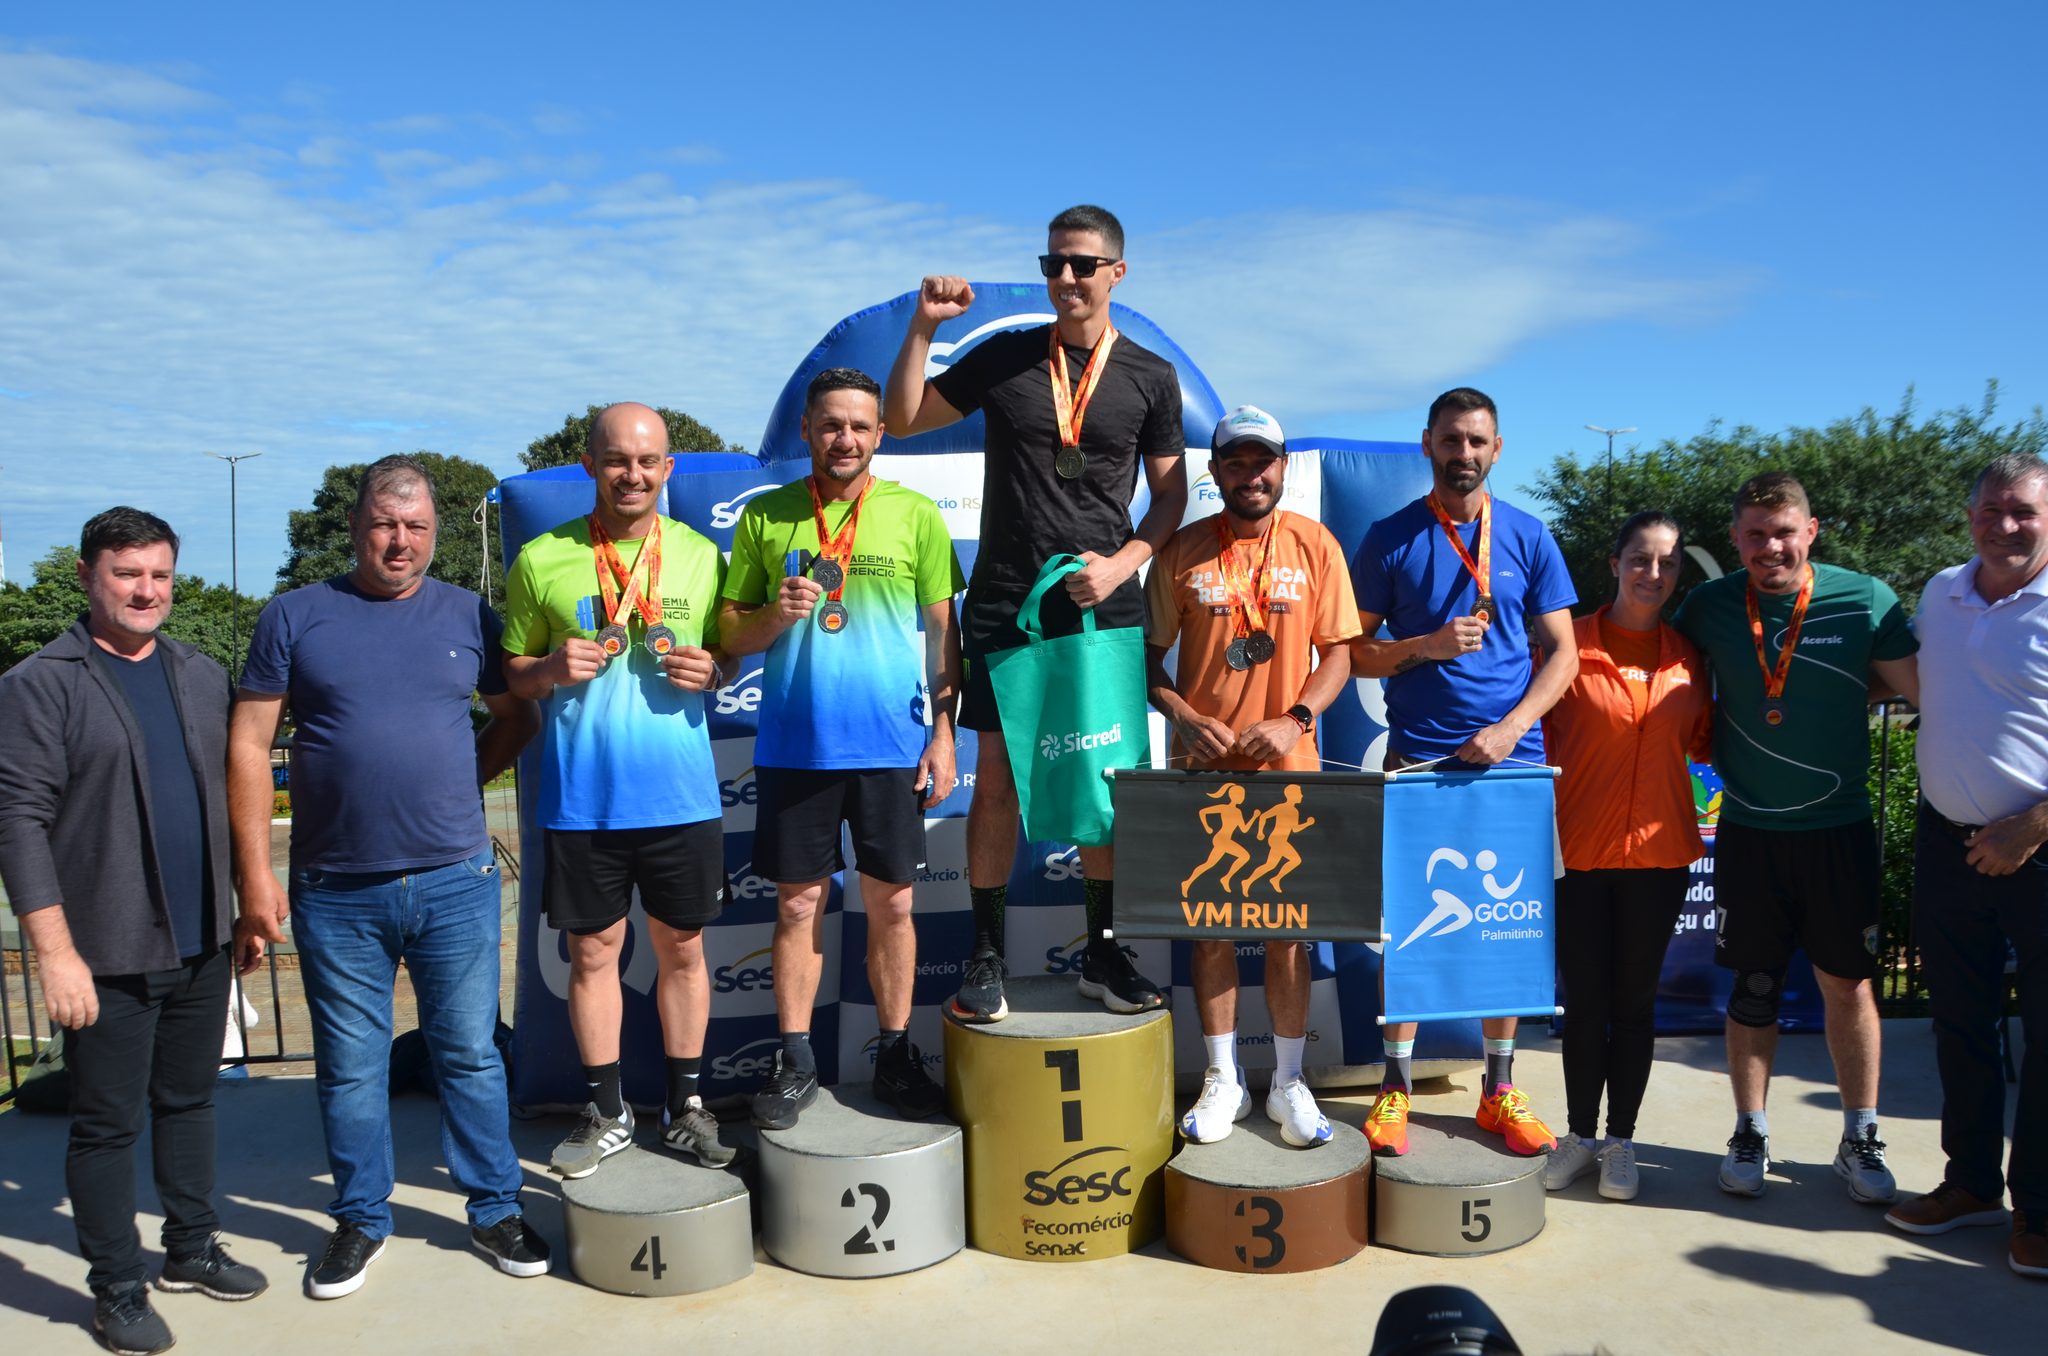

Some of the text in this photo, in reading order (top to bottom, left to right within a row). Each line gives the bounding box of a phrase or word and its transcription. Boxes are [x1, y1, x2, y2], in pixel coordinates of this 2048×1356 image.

[836, 555, 895, 565] ADEMIA
[1064, 723, 1122, 753] Sicredi
[1181, 901, 1308, 929] VM RUN
[1474, 900, 1543, 923] GCOR
[1482, 928, 1543, 941] Palmitinho
[1044, 1048, 1083, 1143] 1
[1023, 1164, 1132, 1206] Sesc
[841, 1183, 895, 1255] 2
[1023, 1212, 1133, 1235] Fecomércio
[1234, 1196, 1286, 1269] 3
[1461, 1198, 1491, 1243] 5
[630, 1236, 667, 1280] 4
[1025, 1241, 1087, 1256] Senac
